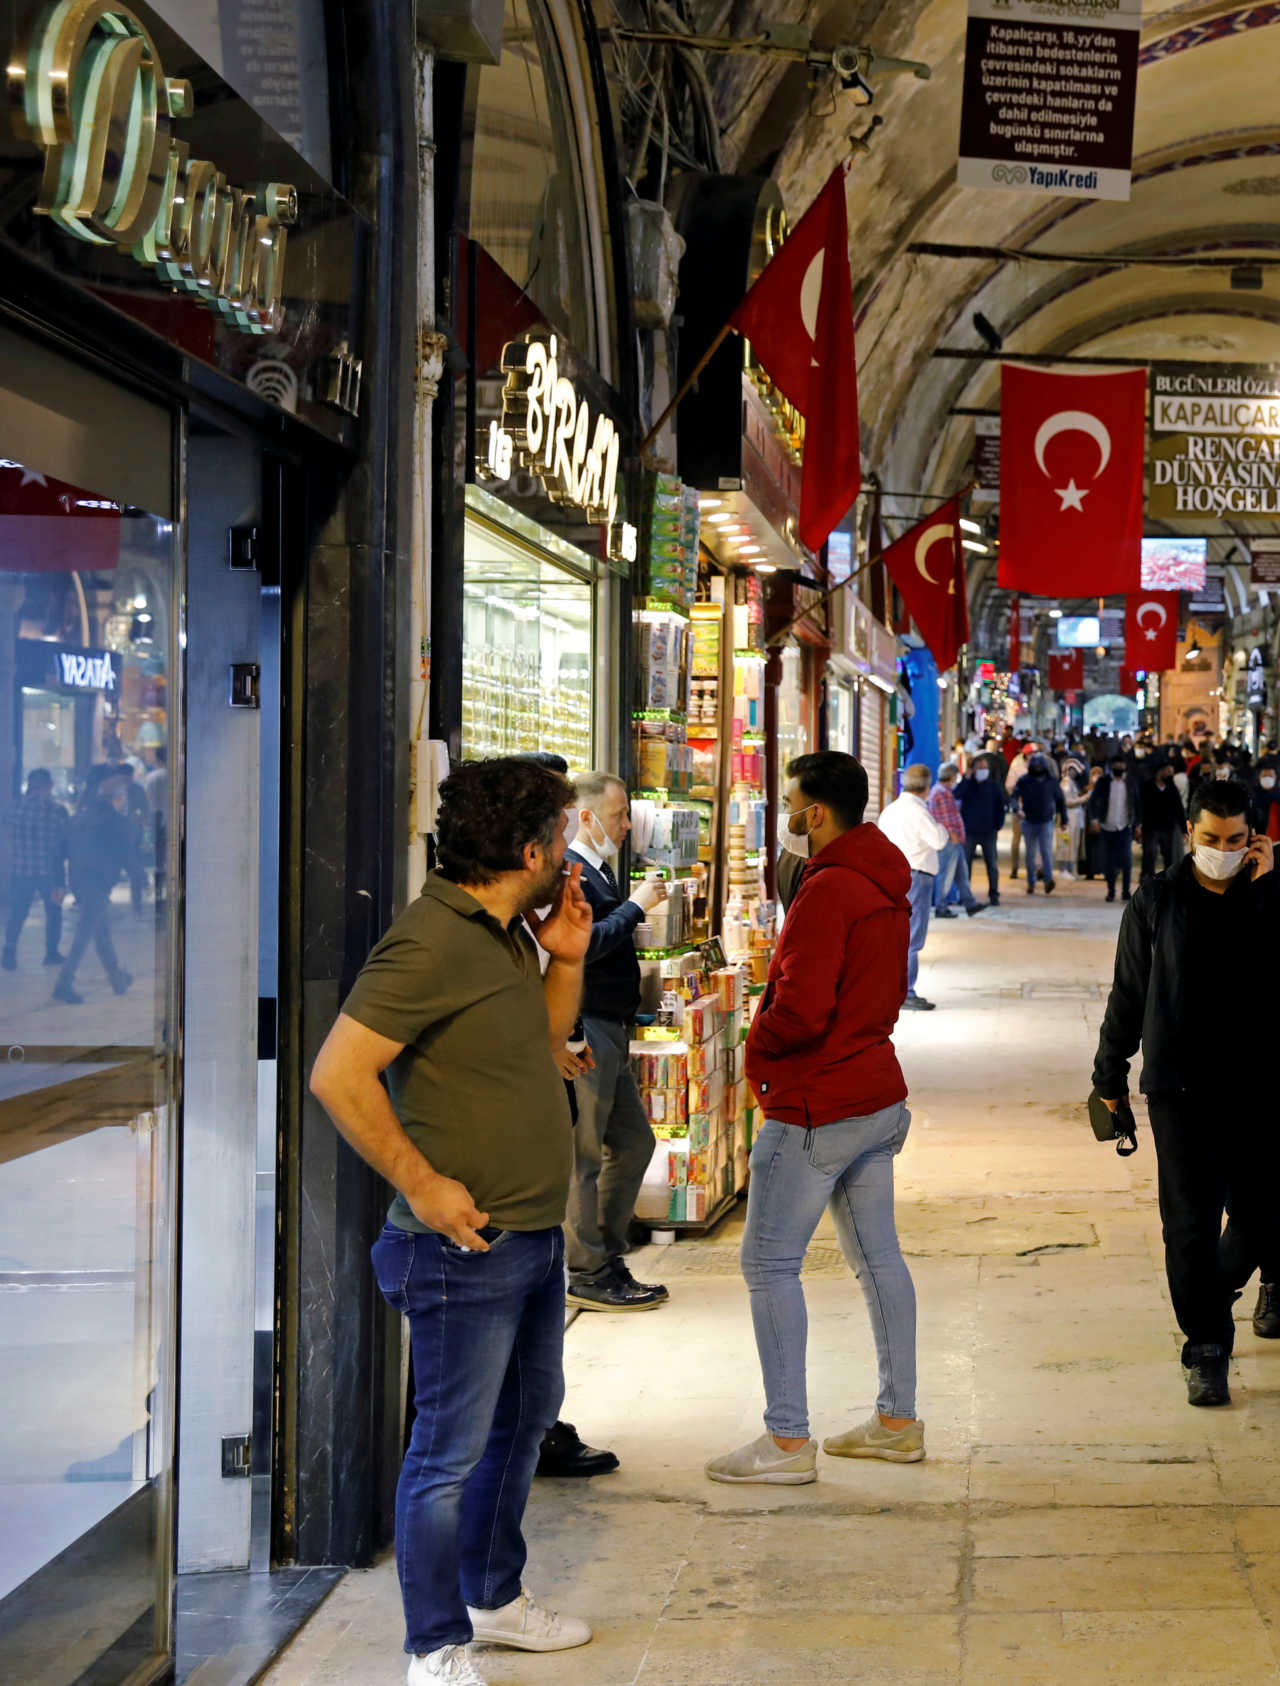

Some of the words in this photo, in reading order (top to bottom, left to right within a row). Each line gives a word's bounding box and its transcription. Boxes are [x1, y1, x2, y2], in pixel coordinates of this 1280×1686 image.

[990, 26, 1059, 46] Kapalıçarşı,
[987, 42, 1033, 57] itibaren
[1036, 46, 1117, 64] bedestenlerin
[981, 59, 1056, 75] çevresindeki
[1059, 64, 1121, 80] sokakların
[982, 74, 1029, 88] üzerinin
[1033, 78, 1101, 95] kapatılması
[1104, 86, 1118, 96] ve
[986, 91, 1044, 106] çevredeki
[1047, 96, 1095, 110] hanların
[1098, 99, 1112, 111] da
[999, 107, 1028, 120] dahil
[1031, 110, 1097, 126] edilmesiyle
[990, 122, 1041, 139] bugünkü
[1044, 126, 1104, 143] sınırlarına
[1015, 141, 1078, 158] ulaşmıştır.
[1029, 167, 1097, 189] YapıKredi
[1156, 373, 1242, 394] BUGÜNLERİ
